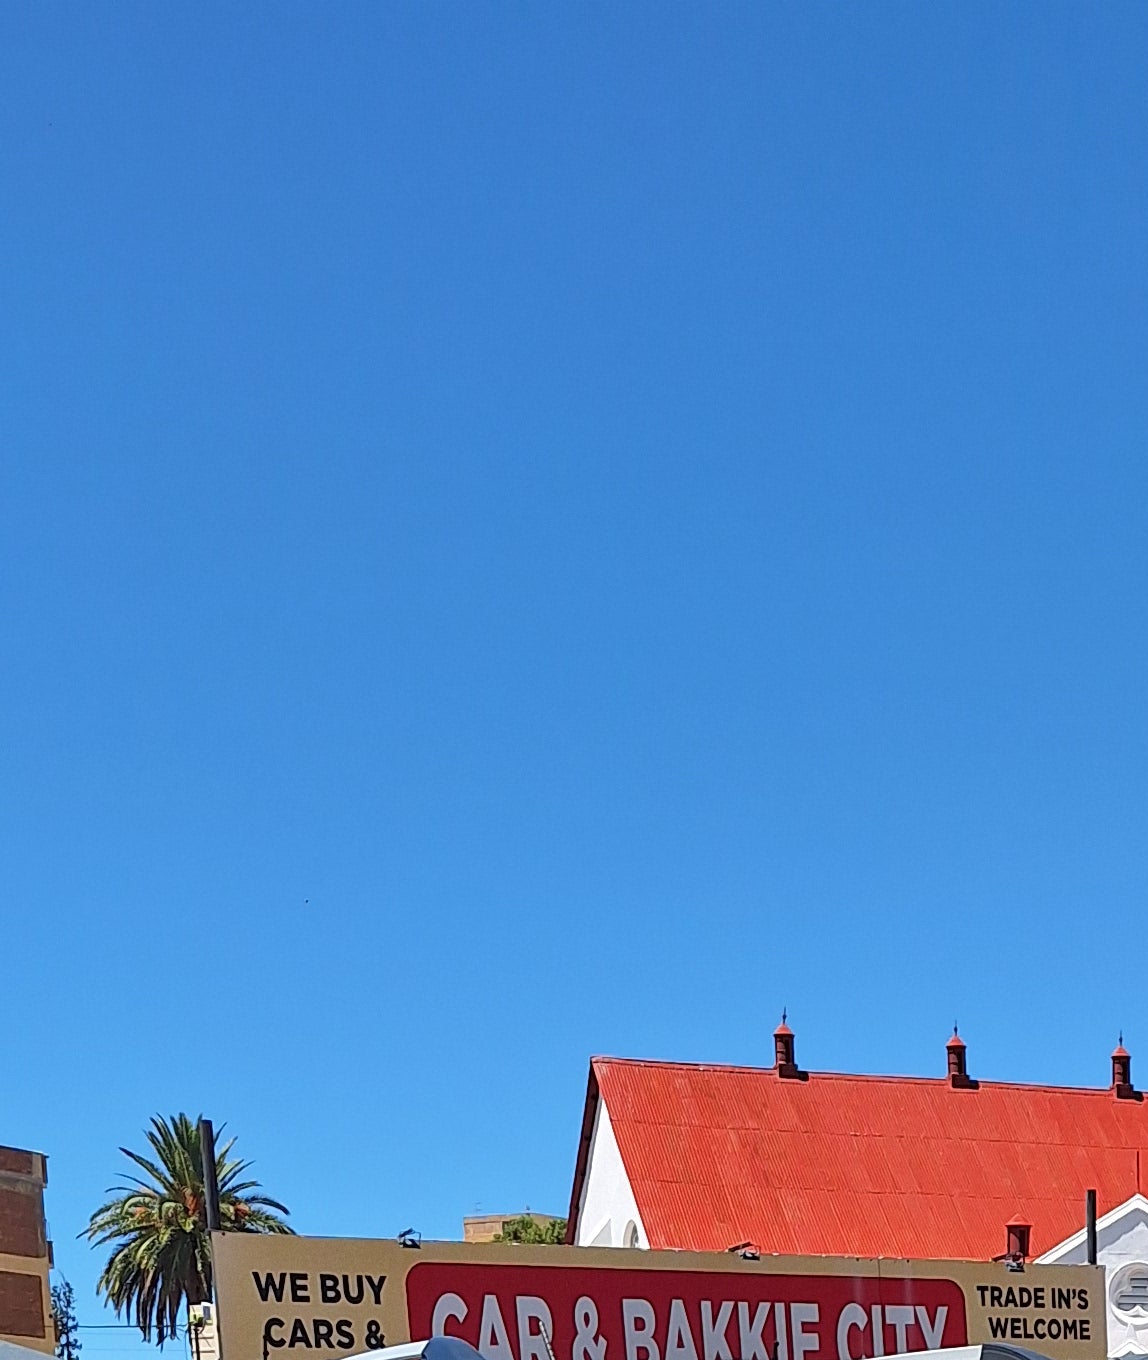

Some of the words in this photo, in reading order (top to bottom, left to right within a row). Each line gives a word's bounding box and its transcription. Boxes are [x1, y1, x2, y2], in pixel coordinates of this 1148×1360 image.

[252, 1271, 311, 1302] WE
[320, 1273, 387, 1305] BUY
[976, 1285, 1045, 1309] TRADE
[1051, 1288, 1089, 1310] IN'S
[264, 1317, 356, 1349] CARS
[365, 1319, 386, 1349] &
[988, 1316, 1091, 1340] WELCOME
